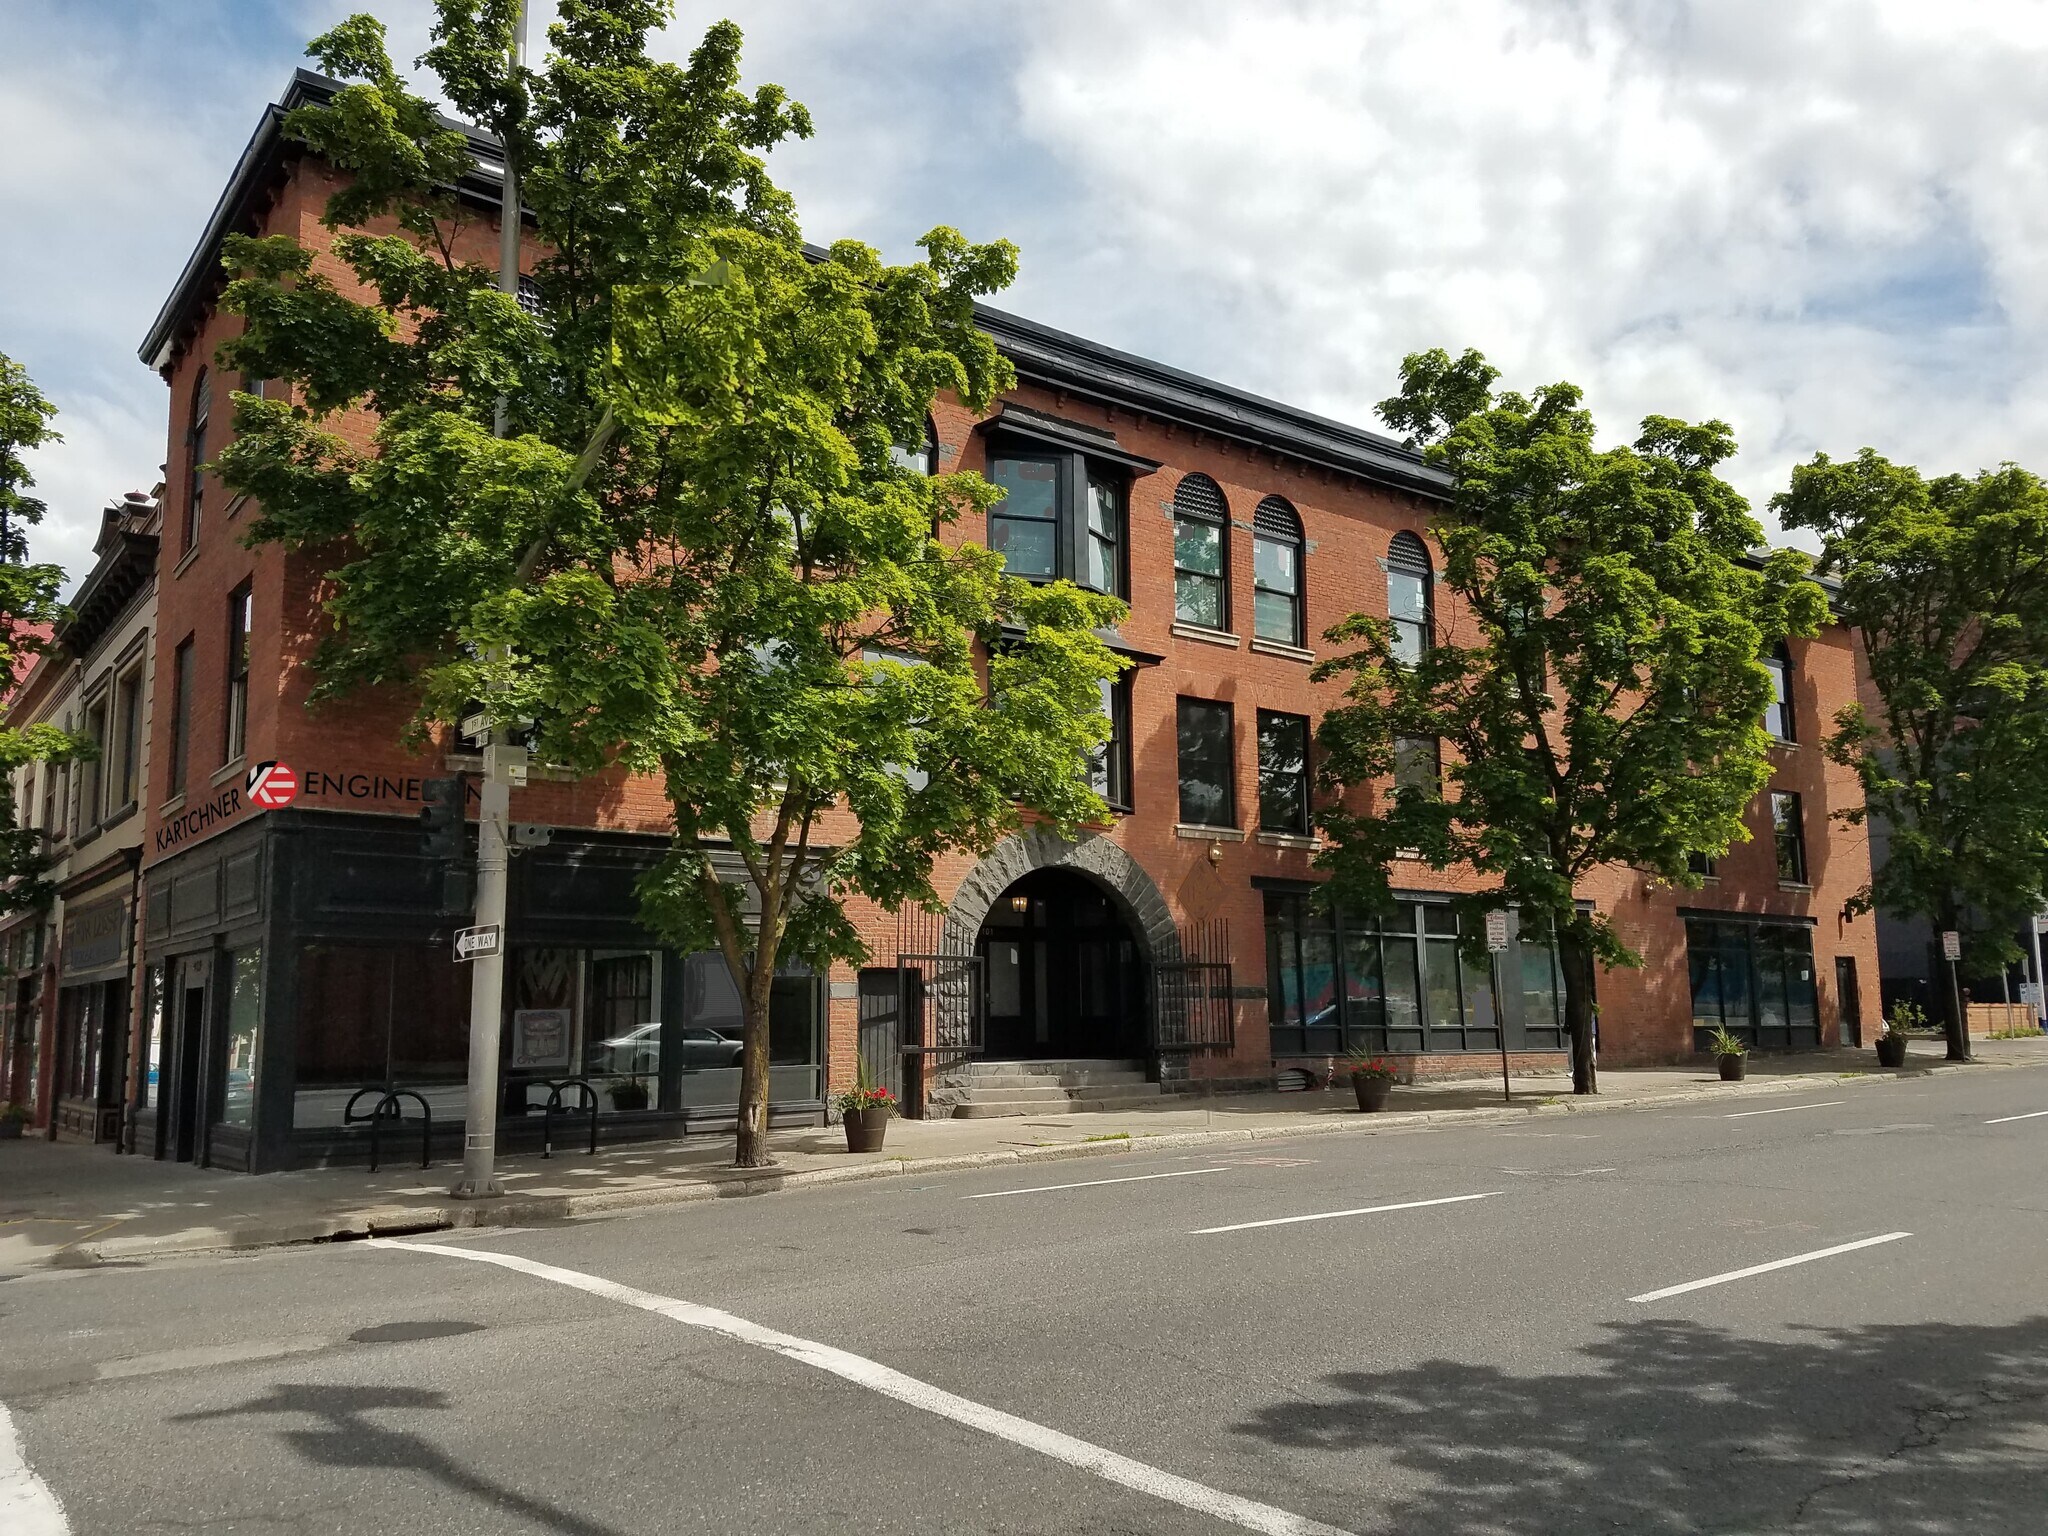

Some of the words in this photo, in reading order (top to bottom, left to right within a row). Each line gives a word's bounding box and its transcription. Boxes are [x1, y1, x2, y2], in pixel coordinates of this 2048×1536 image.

[304, 771, 483, 804] ENGINEN
[156, 788, 242, 853] KARTCHNER
[464, 936, 475, 950] ONE
[477, 934, 494, 948] WAY
